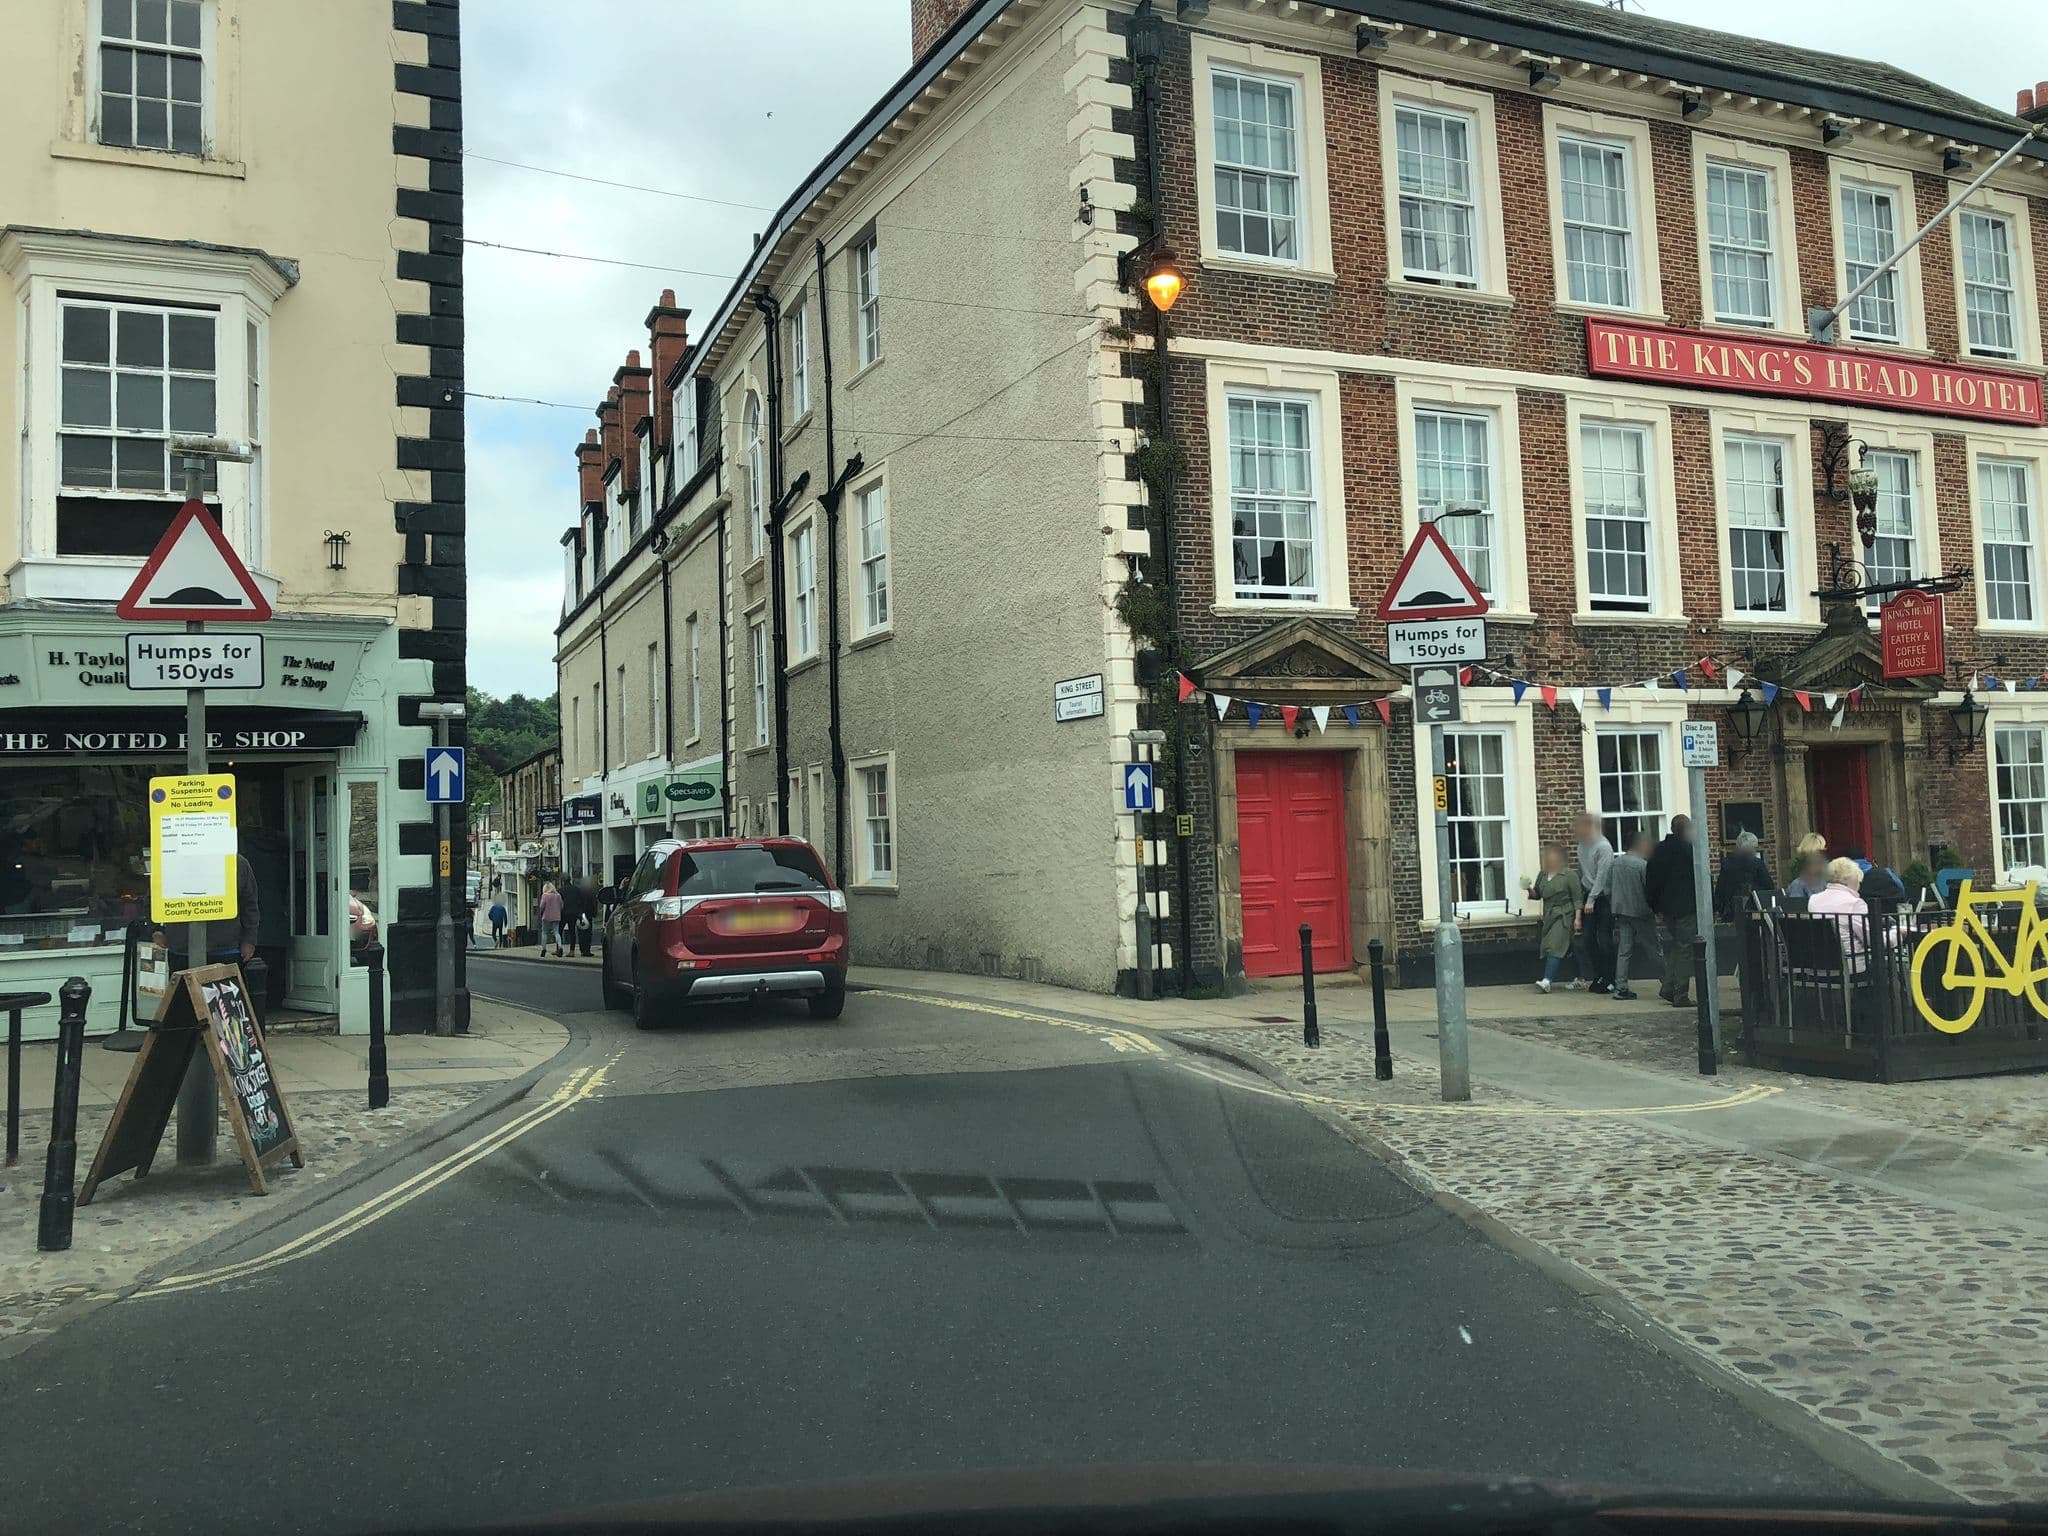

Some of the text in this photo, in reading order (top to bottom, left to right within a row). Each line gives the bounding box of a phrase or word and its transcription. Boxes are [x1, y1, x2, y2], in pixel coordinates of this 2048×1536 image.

[1600, 331, 2035, 414] THE KING'S HEAD HOTEL
[1887, 606, 1932, 620] KING'S HEAD
[1897, 620, 1923, 631] HOTEL
[1395, 626, 1478, 642] Humps for
[1891, 631, 1930, 645] EATERY &
[138, 643, 251, 661] Humps for
[1409, 644, 1466, 658] 150yds
[1895, 645, 1927, 656] COFFEE
[48, 651, 125, 668] H. Taylo
[282, 655, 336, 671] The Noted
[1897, 657, 1926, 668] HOUSE
[79, 671, 125, 686] Quali
[157, 664, 234, 682] 150yds
[281, 674, 328, 692] Pie Shop
[1061, 680, 1095, 694] KING STREET
[0, 731, 305, 749] HE NOTED PE SHOP
[171, 787, 213, 795] Suspension
[669, 787, 711, 796] Specsavers
[184, 800, 213, 808] Loading
[577, 809, 595, 818] HILL
[164, 900, 223, 909] North Yorkshire
[165, 907, 223, 916] County Council
